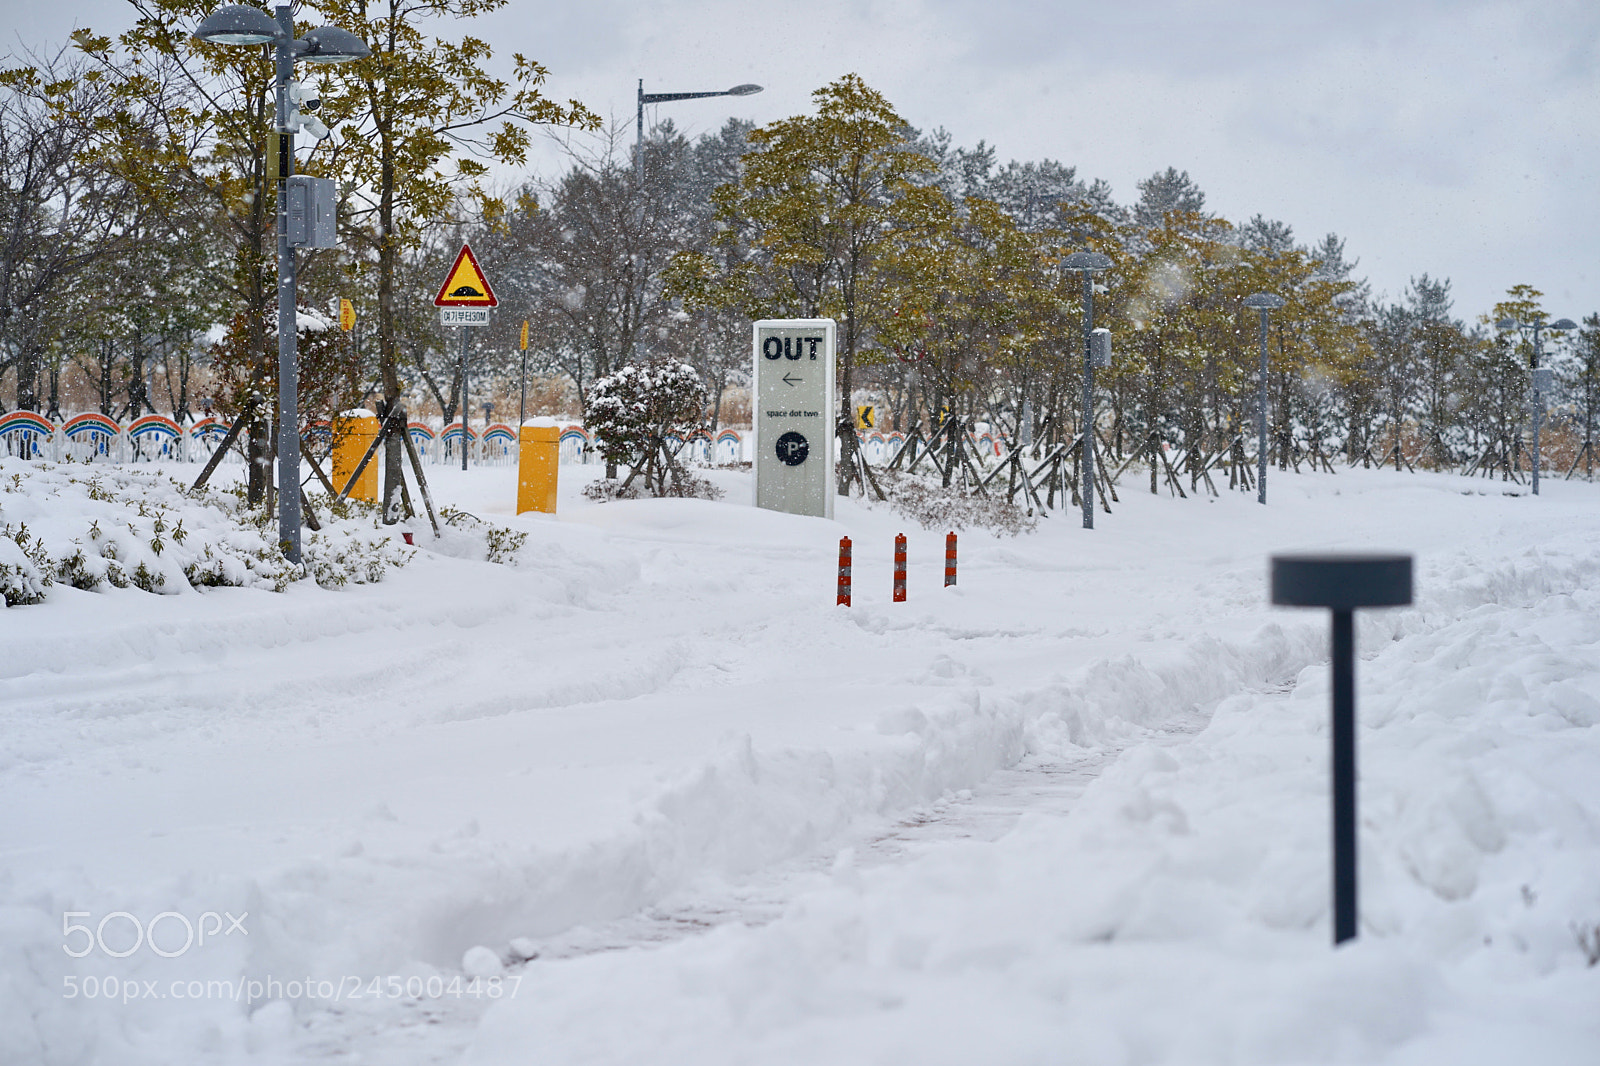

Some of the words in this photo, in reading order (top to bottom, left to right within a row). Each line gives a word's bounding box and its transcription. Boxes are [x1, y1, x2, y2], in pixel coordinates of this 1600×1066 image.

[763, 336, 823, 360] OUT
[789, 409, 802, 417] dot
[787, 441, 800, 456] P
